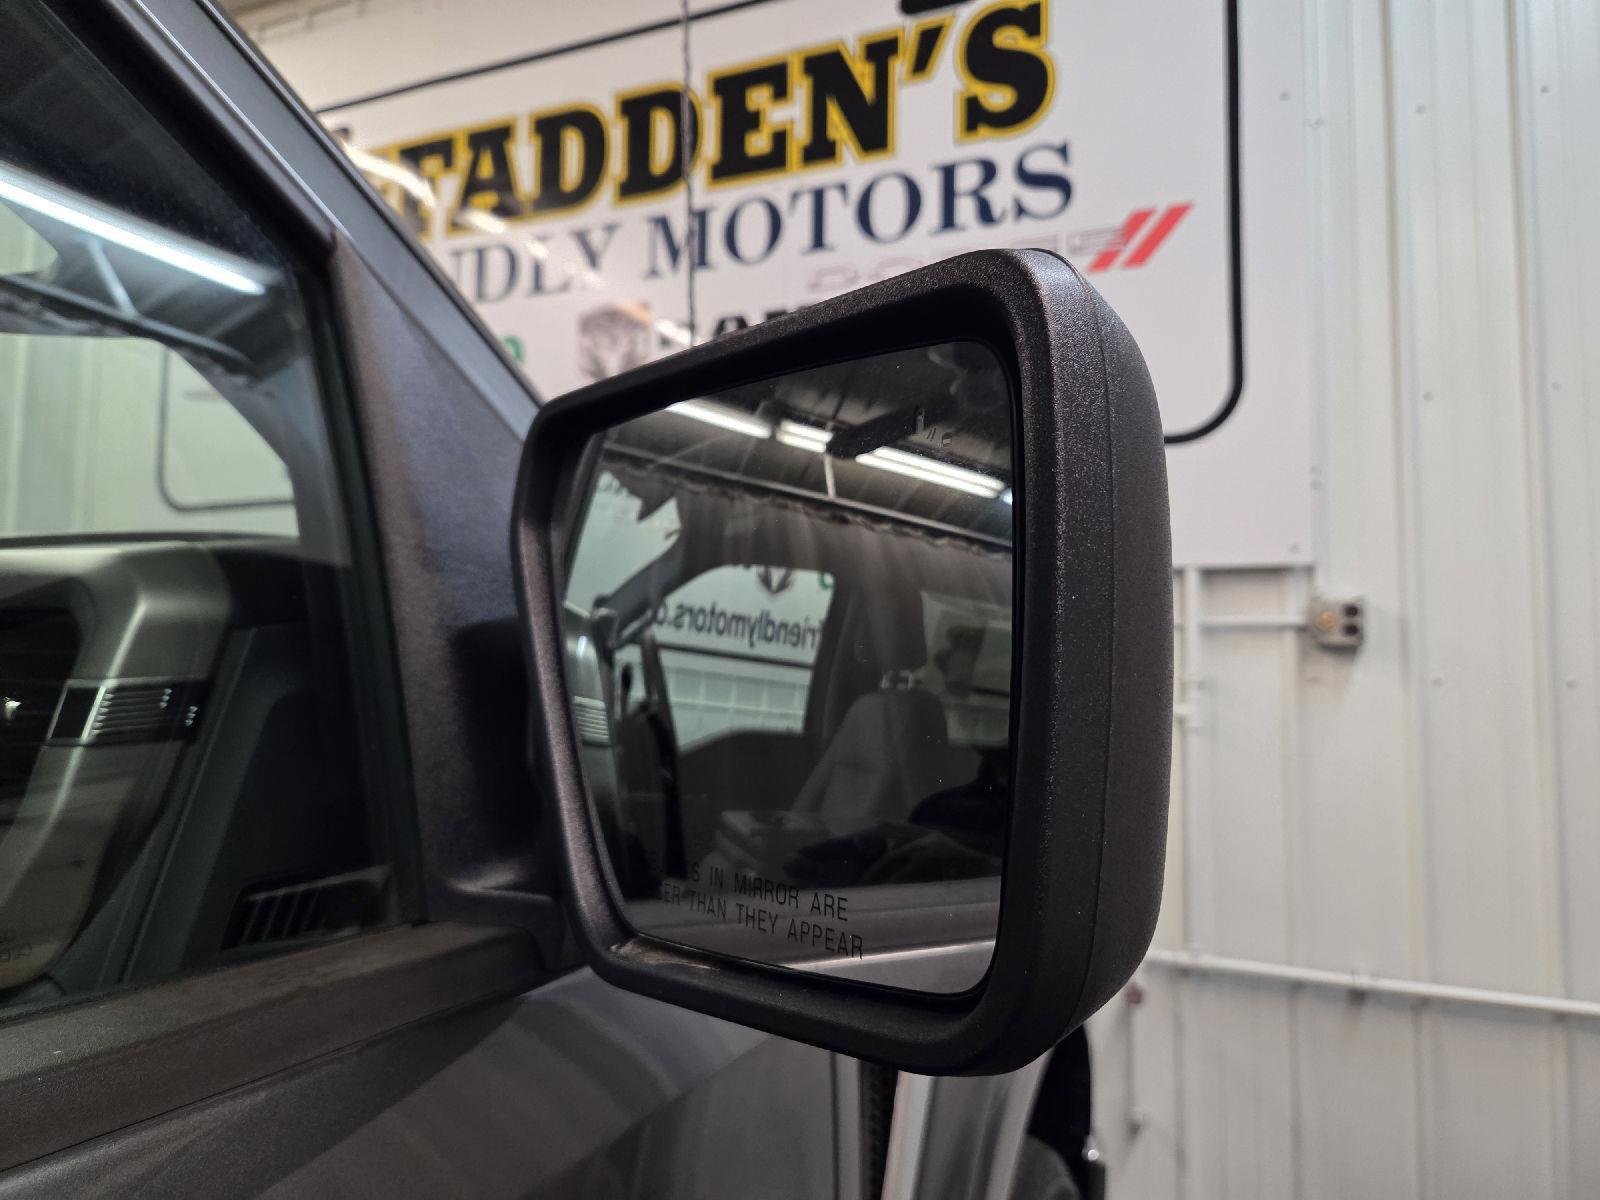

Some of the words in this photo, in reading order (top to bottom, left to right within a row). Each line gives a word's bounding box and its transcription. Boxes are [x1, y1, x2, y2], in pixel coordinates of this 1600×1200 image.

[368, 0, 1057, 243] FADDEN'S
[640, 141, 1075, 281] MOTORS
[688, 889, 727, 921] THAN
[736, 902, 778, 934] THEY
[787, 918, 864, 960] APPEAR
[709, 866, 724, 889] IN
[734, 872, 800, 909] MIRROR
[810, 892, 849, 922] ARE
